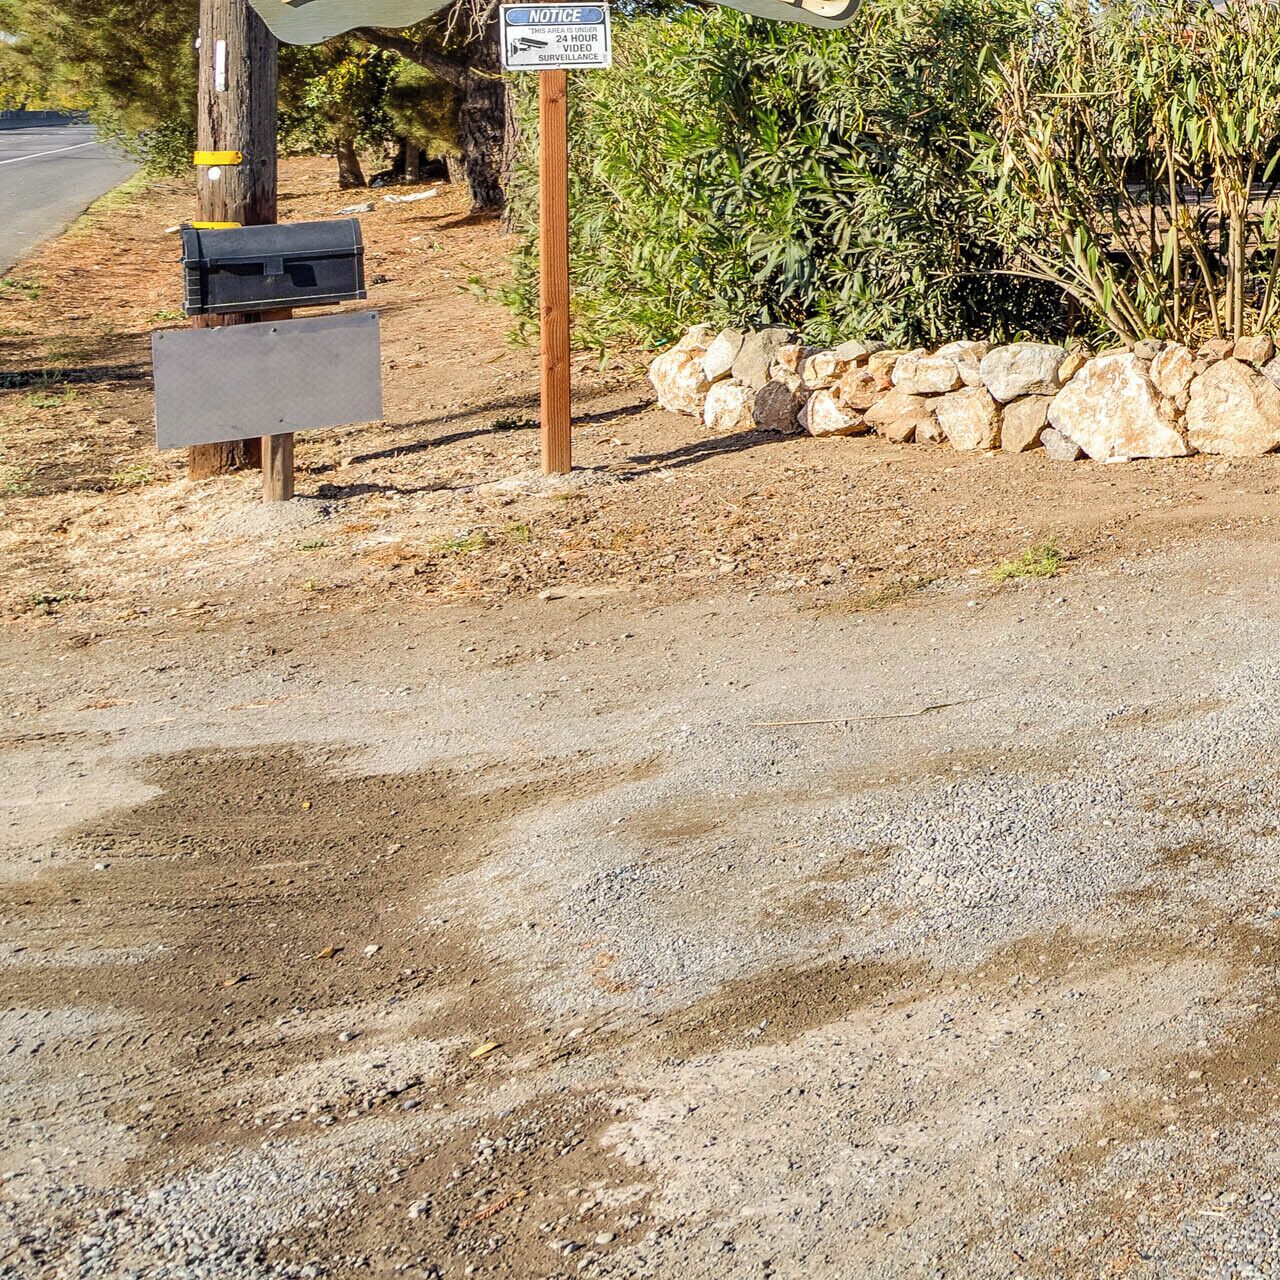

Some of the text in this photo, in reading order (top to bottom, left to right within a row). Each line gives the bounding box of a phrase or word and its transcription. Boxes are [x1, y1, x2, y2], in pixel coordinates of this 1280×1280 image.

[529, 10, 581, 22] NOTICE
[556, 34, 598, 42] 24 HOUR
[563, 44, 592, 52] VIDEO
[538, 53, 599, 61] SURVEILLANCE
